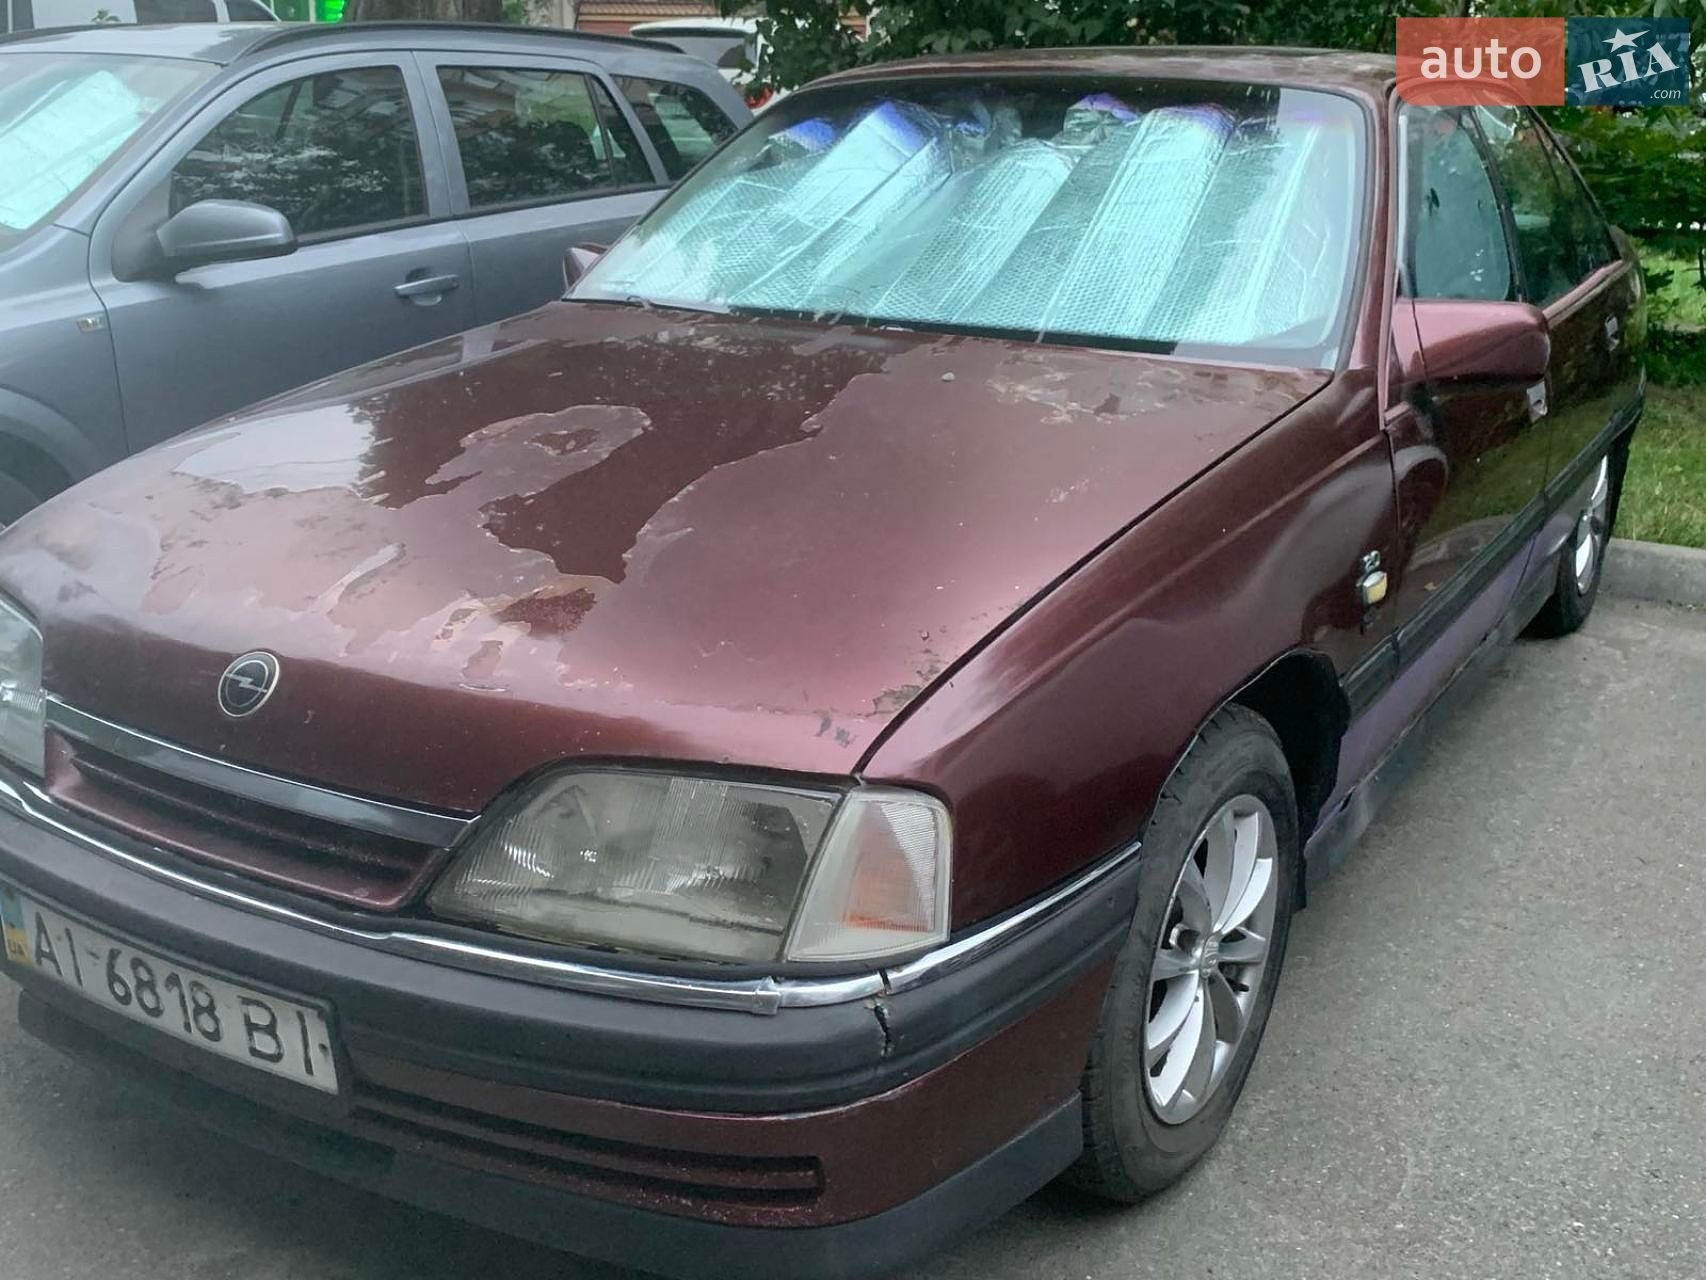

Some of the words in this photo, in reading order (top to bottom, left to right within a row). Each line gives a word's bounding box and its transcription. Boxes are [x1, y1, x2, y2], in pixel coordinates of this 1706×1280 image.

[35, 911, 84, 988] AI
[105, 947, 223, 1042] 6818
[238, 995, 314, 1077] BI
